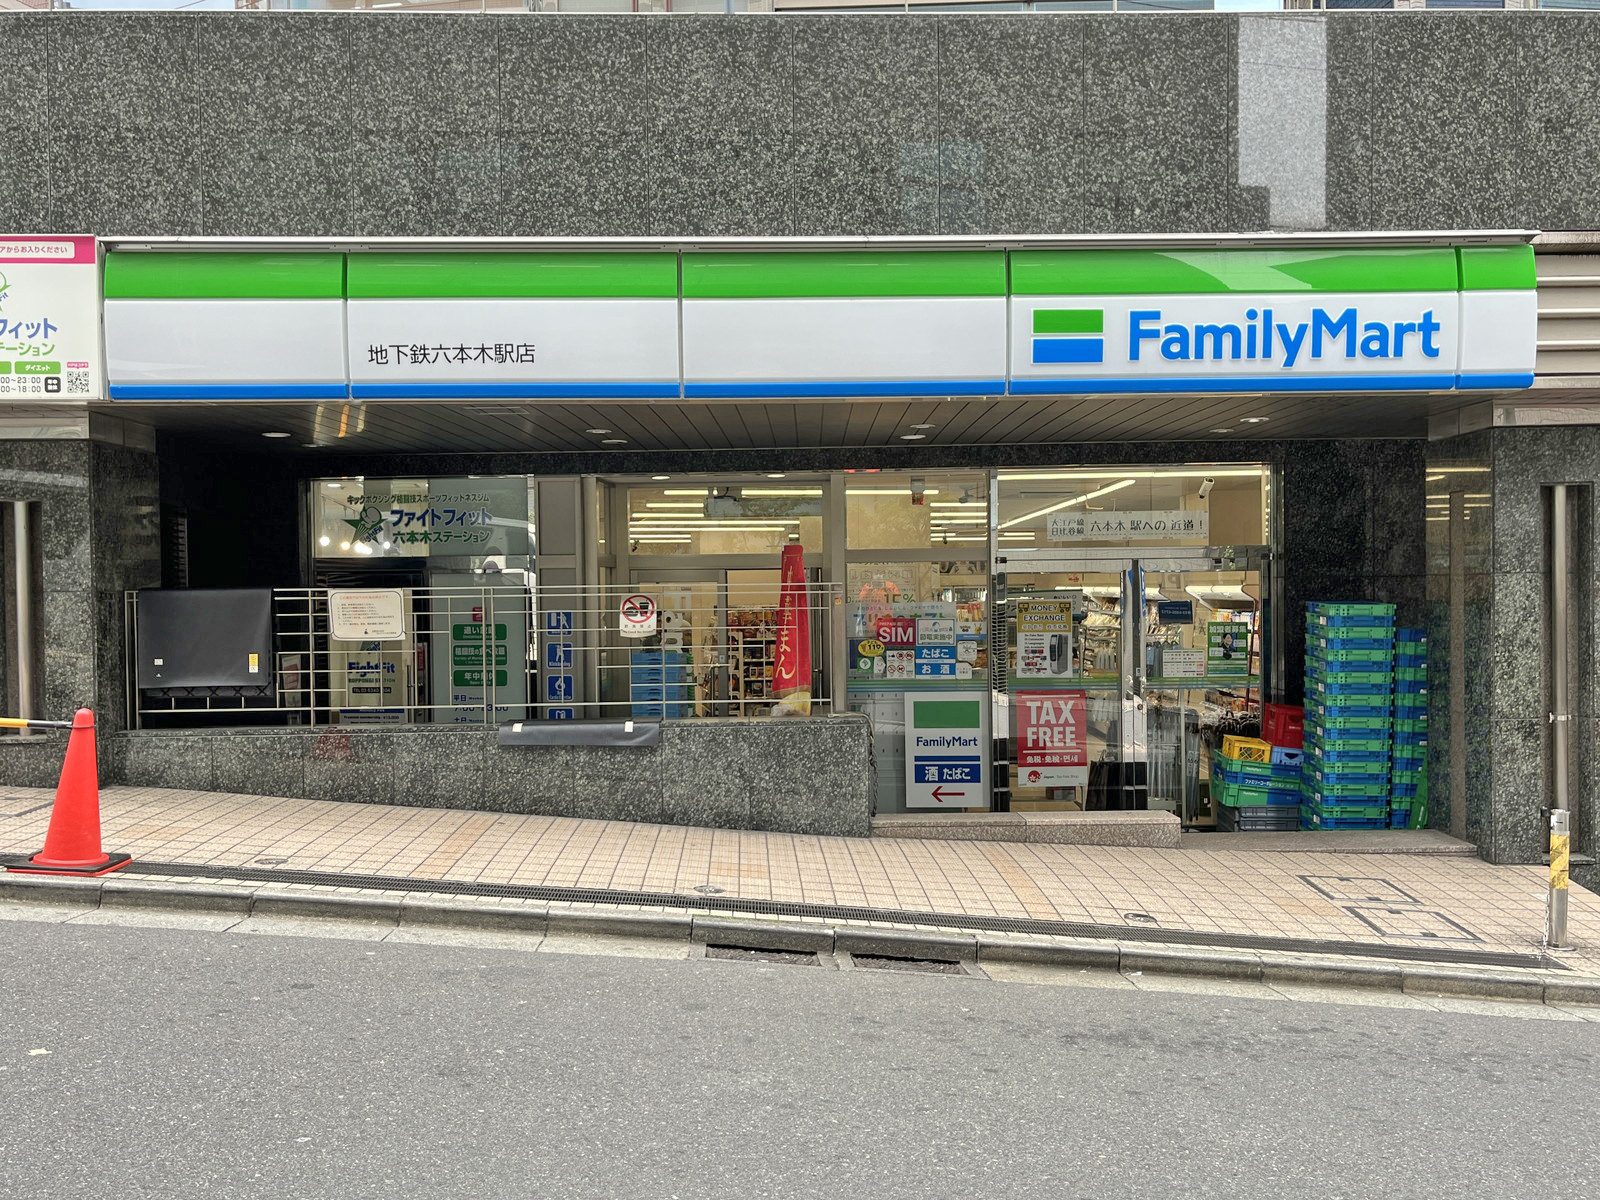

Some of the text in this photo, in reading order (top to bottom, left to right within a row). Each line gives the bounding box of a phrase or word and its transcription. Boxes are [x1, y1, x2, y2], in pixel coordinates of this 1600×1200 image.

[1129, 307, 1441, 368] FamilyMart
[368, 343, 536, 365] 地下鉄六本木駅店
[390, 507, 492, 527] ファイトフィット
[1052, 518, 1085, 527] 大江戸線
[392, 530, 490, 544] 六本木ステーション
[1051, 527, 1085, 536] 日比谷線
[1031, 604, 1058, 612] MONEY
[1023, 614, 1066, 622] EXCHANGE
[878, 627, 914, 643] SIM
[921, 648, 950, 658] たばこ
[921, 664, 950, 674] お酒
[1026, 700, 1075, 725] TAX
[916, 736, 978, 749] FamilyMart
[1027, 726, 1076, 748] FREE
[924, 766, 971, 781] 酒 たばこ
